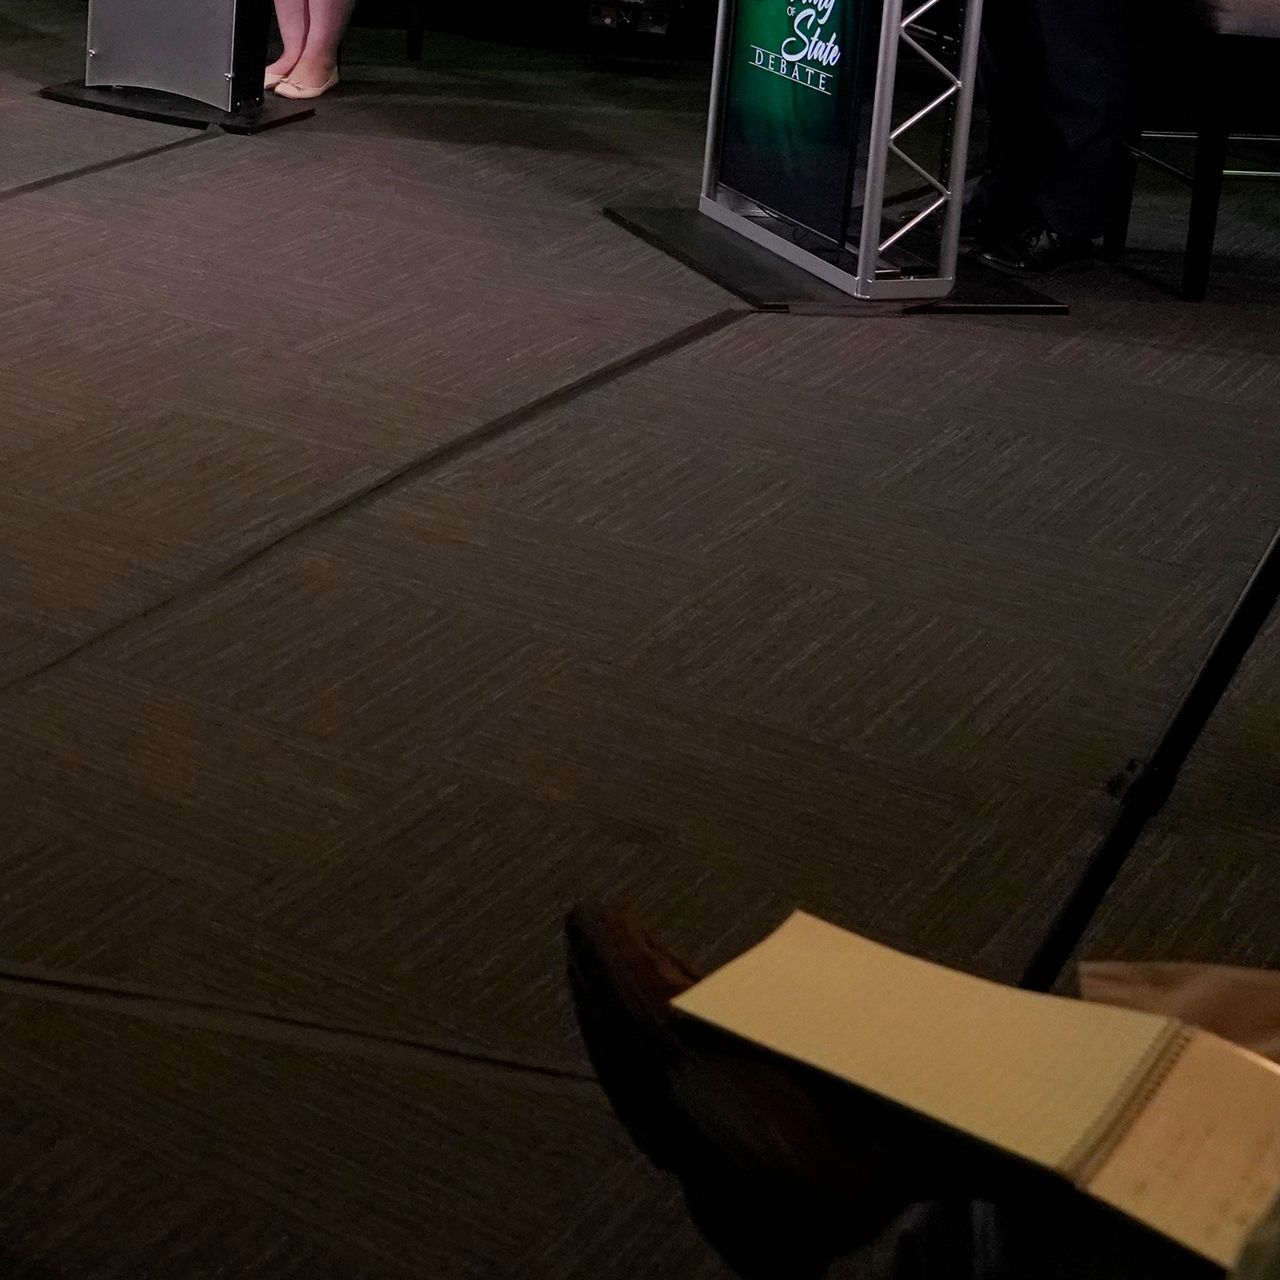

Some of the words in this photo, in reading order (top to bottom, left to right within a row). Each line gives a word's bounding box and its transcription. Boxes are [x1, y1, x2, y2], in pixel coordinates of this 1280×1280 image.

[787, 5, 796, 17] OF
[781, 8, 840, 67] State
[755, 48, 827, 91] DEBATE
